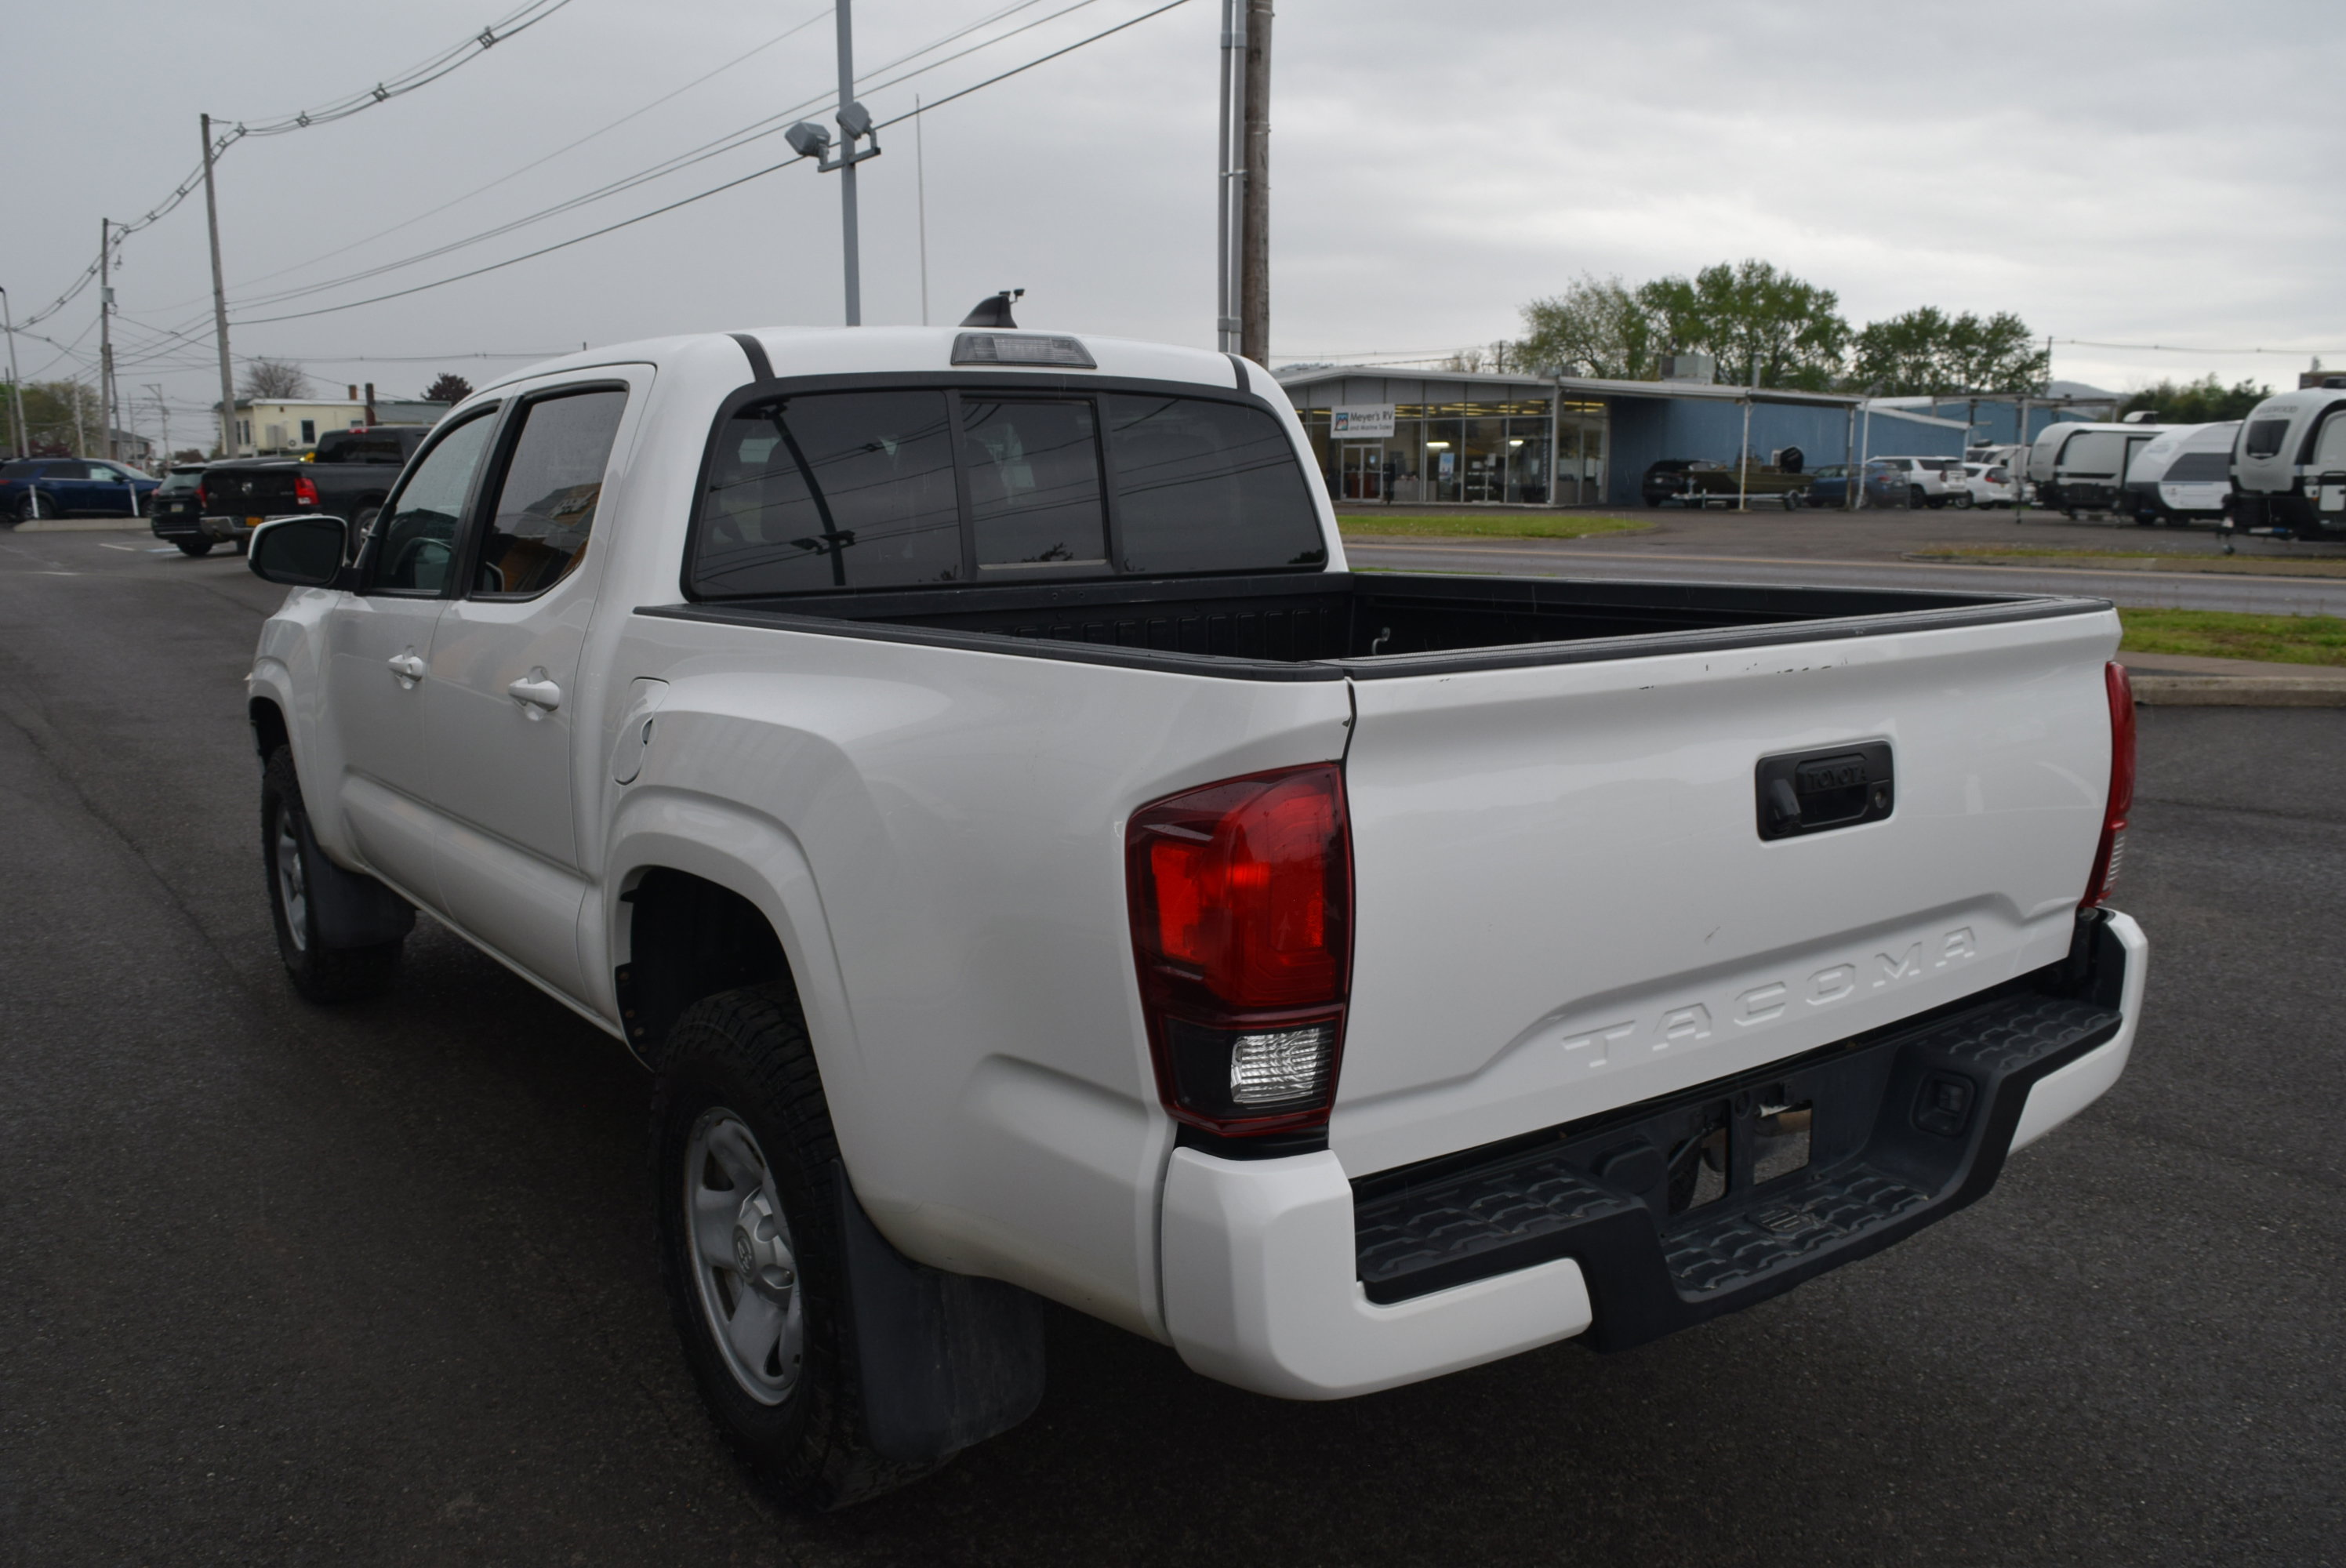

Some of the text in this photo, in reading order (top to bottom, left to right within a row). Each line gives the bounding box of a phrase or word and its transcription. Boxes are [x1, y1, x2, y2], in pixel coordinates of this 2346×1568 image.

[1350, 411, 1393, 423] Meyer's RV
[1806, 765, 1868, 789] TOYOTA
[1560, 926, 1976, 1068] TACOMA
